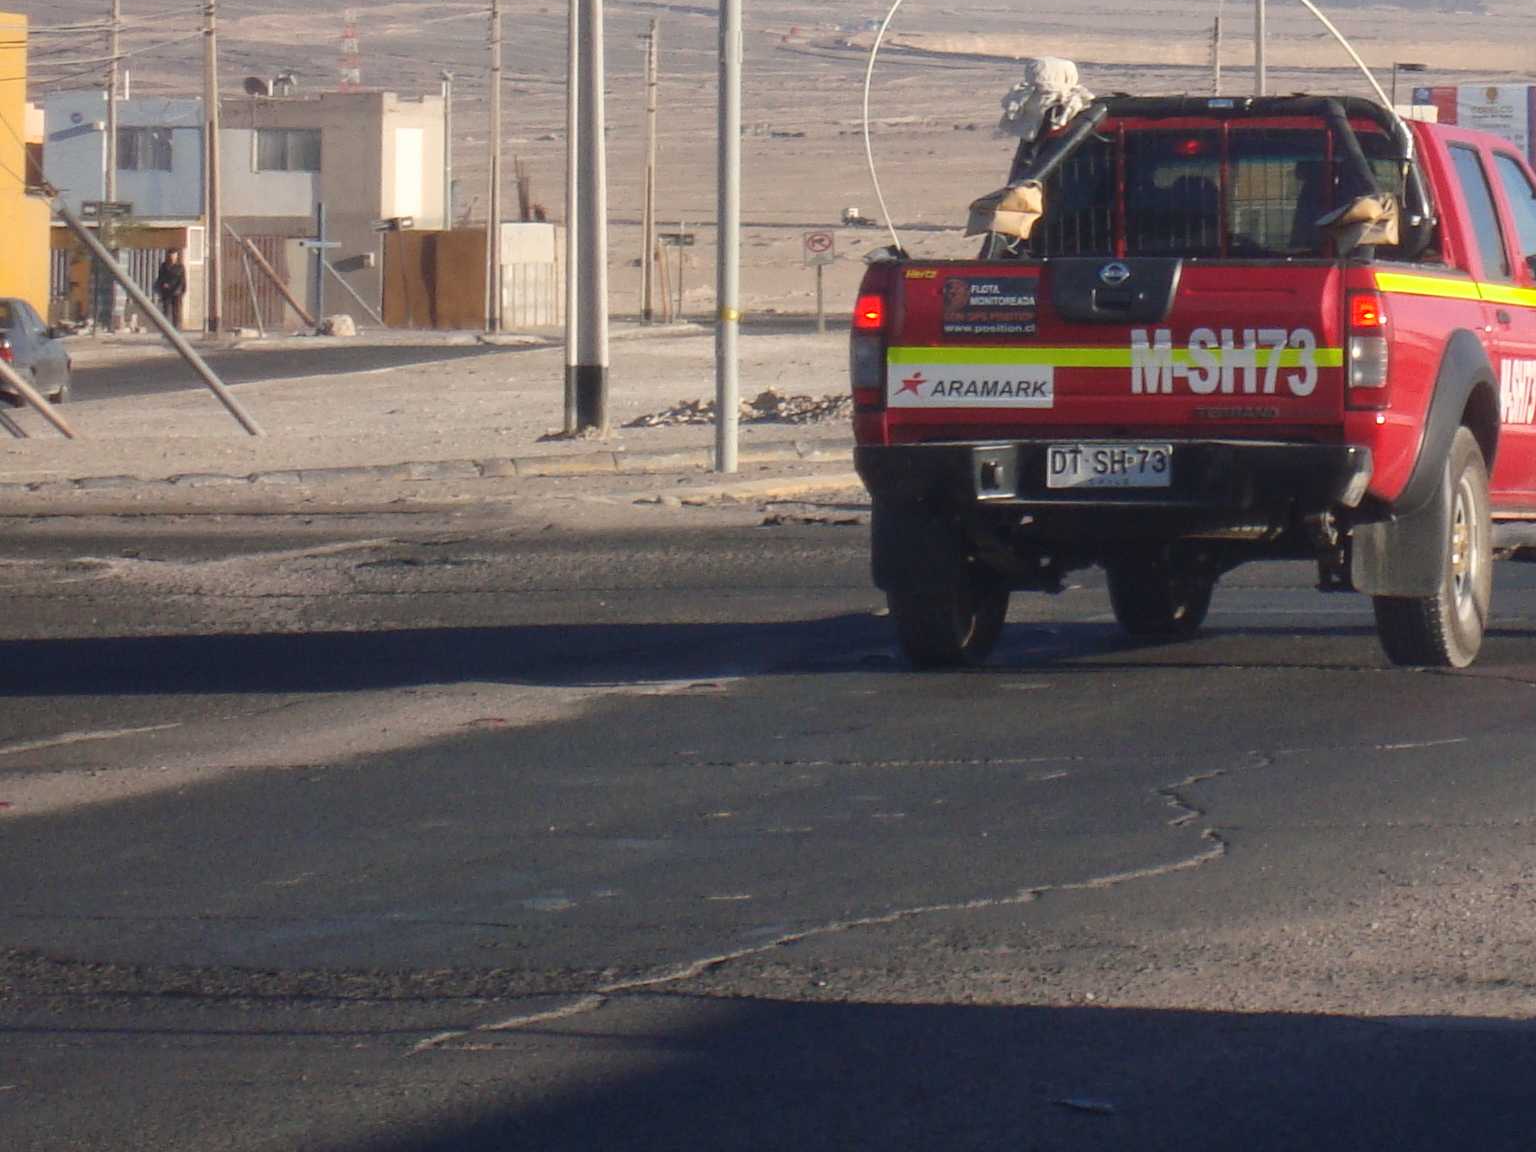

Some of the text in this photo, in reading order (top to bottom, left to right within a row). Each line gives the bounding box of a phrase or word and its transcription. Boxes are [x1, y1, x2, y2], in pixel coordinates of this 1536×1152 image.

[969, 284, 1001, 294] FLOTA
[969, 296, 1036, 306] MONITOREADA
[944, 323, 1036, 334] www.position.cl
[1130, 327, 1319, 397] M-SH73
[930, 379, 1049, 398] ARAMARK
